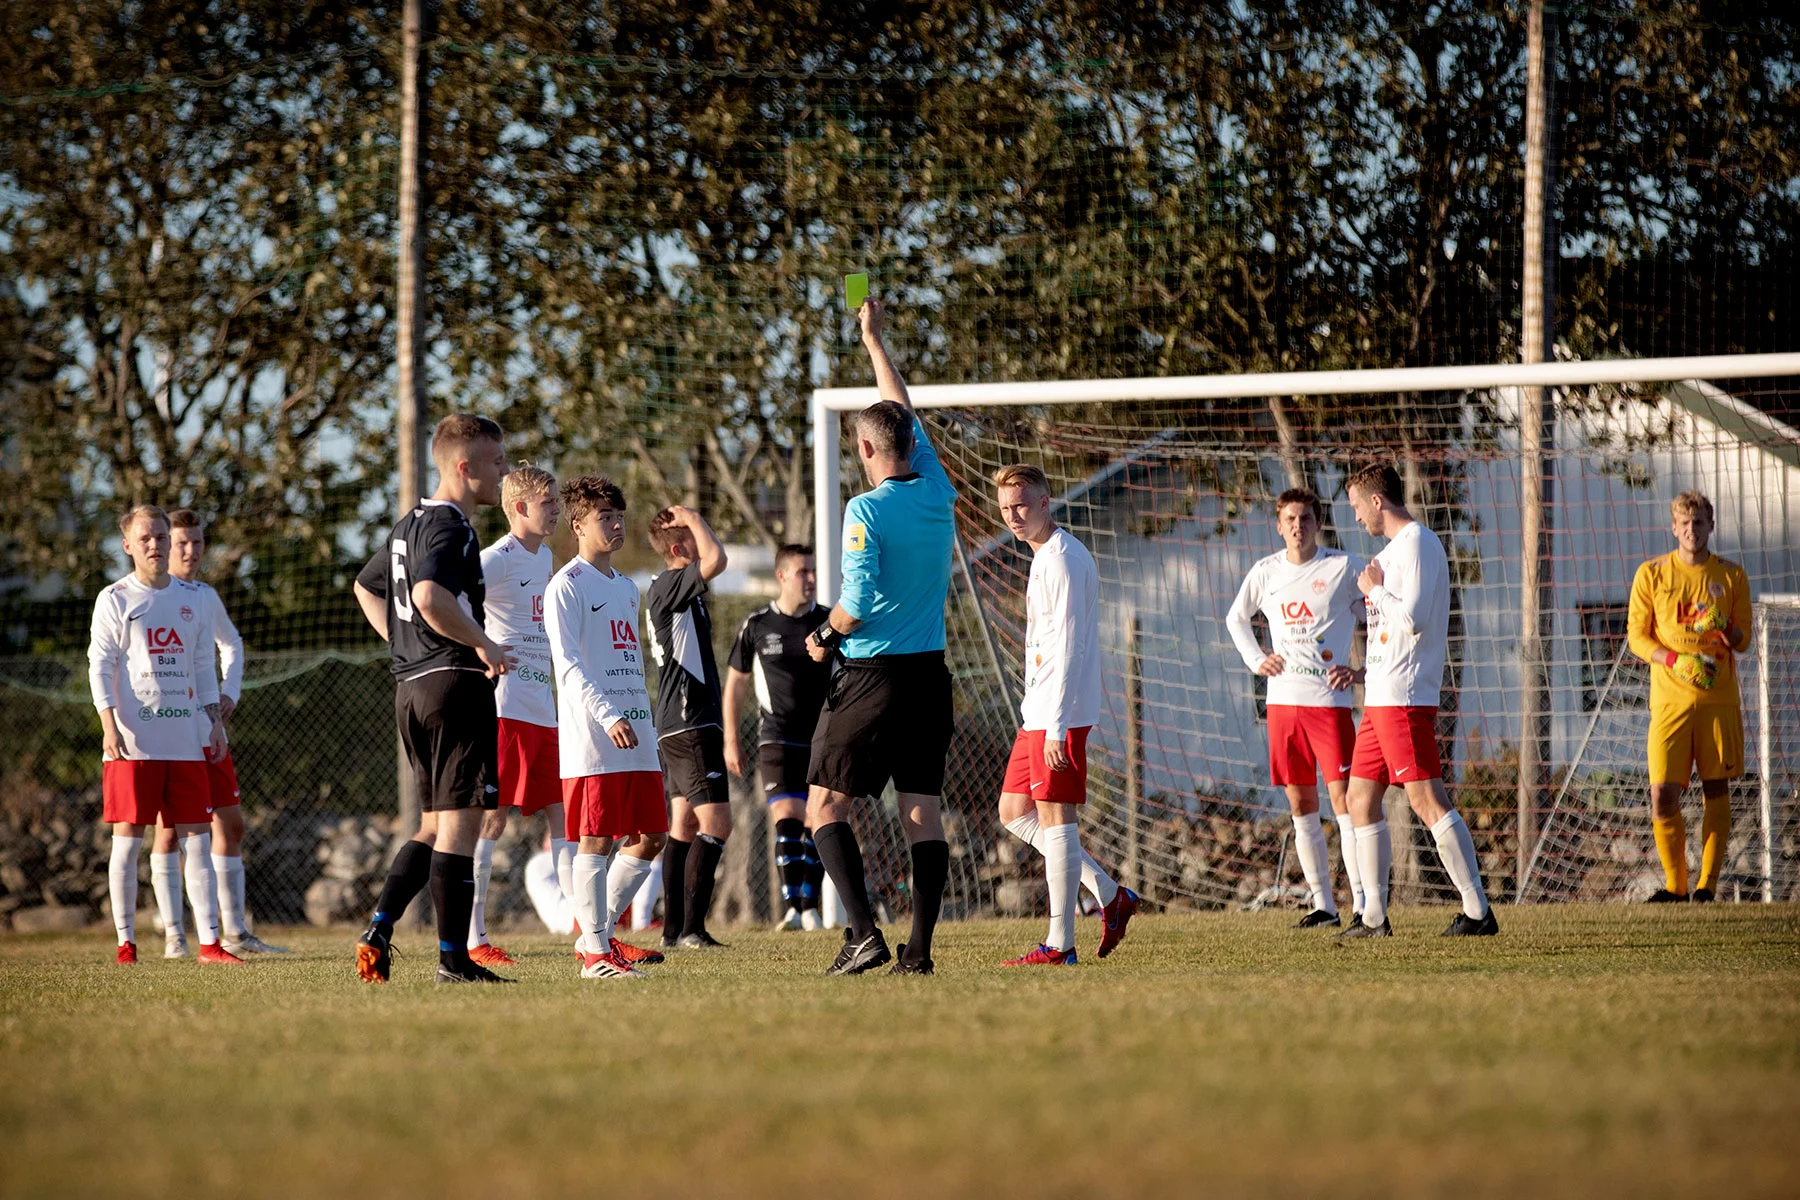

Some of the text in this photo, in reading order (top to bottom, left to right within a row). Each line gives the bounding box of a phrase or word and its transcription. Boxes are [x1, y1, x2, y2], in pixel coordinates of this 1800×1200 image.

[391, 538, 414, 622] 5
[1281, 601, 1314, 620] ICA
[147, 627, 184, 648] ICA
[610, 619, 637, 643] ICA
[157, 655, 177, 666] Bua
[140, 670, 185, 679] VATTENFALL
